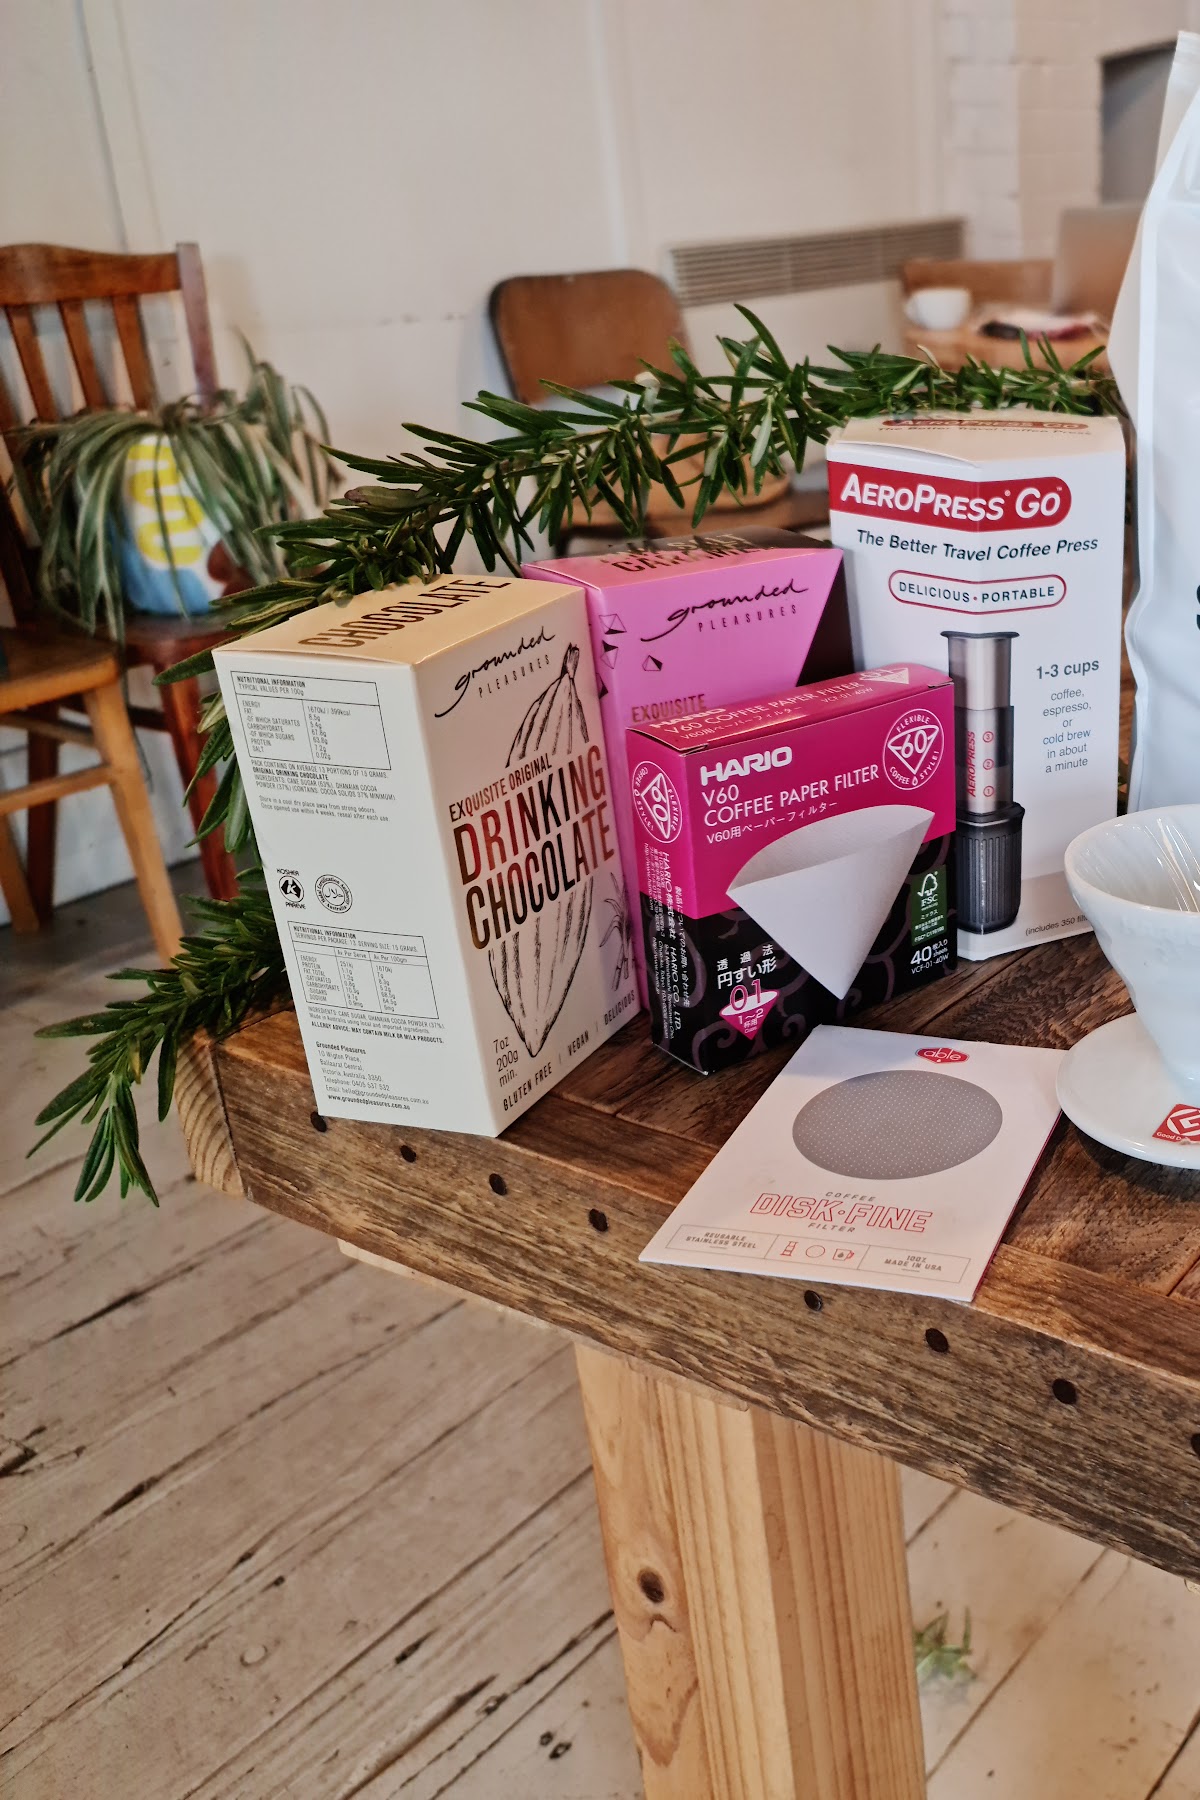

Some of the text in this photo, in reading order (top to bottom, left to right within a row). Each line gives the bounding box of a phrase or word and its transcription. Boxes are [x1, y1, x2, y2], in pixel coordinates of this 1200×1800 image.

[857, 529, 1098, 561] The Better Travel Coffee Press
[899, 581, 1055, 603] DELICIOUS PORTABLE
[298, 579, 511, 648] CHOCOLATE
[640, 579, 808, 642] grounded
[698, 604, 798, 632] PLEASURES
[435, 626, 556, 718] grounded
[478, 654, 551, 698] PLEASURES
[1036, 659, 1100, 680] 1-3 cups
[705, 705, 769, 725] COFFEE
[768, 694, 818, 709] PAPER
[817, 681, 864, 697] FILTER
[1050, 689, 1085, 702] coffee,
[631, 694, 707, 723] EXQUISITE
[1042, 702, 1091, 717] espresso,
[896, 714, 930, 733] FLEXIBLE
[1062, 718, 1073, 728] or
[1042, 728, 1091, 745] cold brew
[1047, 743, 1087, 759] in about
[700, 746, 792, 787] HARIO
[890, 766, 910, 785] COFFEE
[1045, 757, 1088, 774] a minute
[449, 753, 552, 823] EXQUISITE ORIGINAL
[701, 784, 739, 807] V60
[704, 764, 879, 827] COFFEE PAPER FILTER
[453, 745, 607, 885] DRINKING
[466, 801, 614, 950] CHOCOLATE
[921, 894, 938, 907] FSC
[1025, 917, 1075, 936] (includes 350
[670, 947, 679, 982] HARIO
[910, 946, 932, 964] 40
[911, 952, 949, 974] VCF-01-40W
[717, 956, 776, 989] 円すい形
[730, 979, 761, 1011] 01
[496, 1050, 519, 1072] 200g
[503, 990, 635, 1111] GLUTEN FREE VEGAN DELICIOUS
[923, 1046, 961, 1063] able
[499, 1070, 518, 1087] min.
[825, 1191, 877, 1202] COFFEE
[704, 1231, 746, 1242] REUSABLE
[807, 1222, 856, 1233] FILTER
[685, 1236, 757, 1249] STAINLESS STEEL
[884, 1258, 910, 1267] MADE
[924, 1263, 943, 1272] USA
